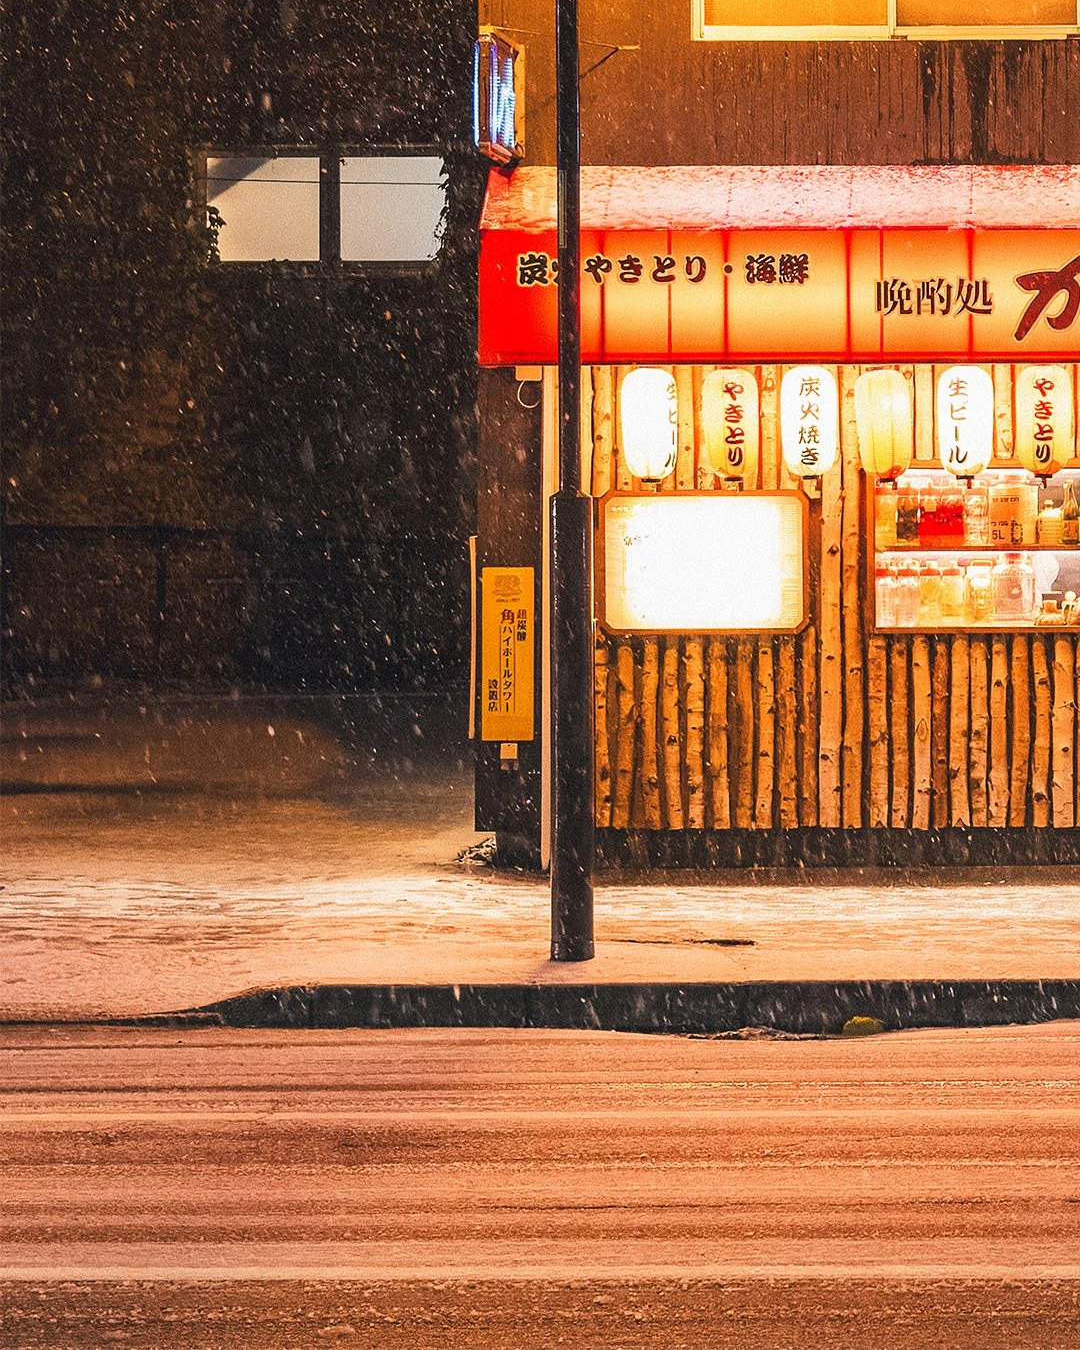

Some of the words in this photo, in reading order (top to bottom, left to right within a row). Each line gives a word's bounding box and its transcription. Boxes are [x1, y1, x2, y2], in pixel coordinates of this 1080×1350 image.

[518, 253, 809, 286] 炭やきとり・海鮮
[875, 279, 993, 317] 晩酌処
[723, 381, 745, 467] やきとり
[798, 376, 820, 465] 炭火焼き
[948, 376, 969, 464] 生ビール
[1033, 377, 1055, 463] やきとり
